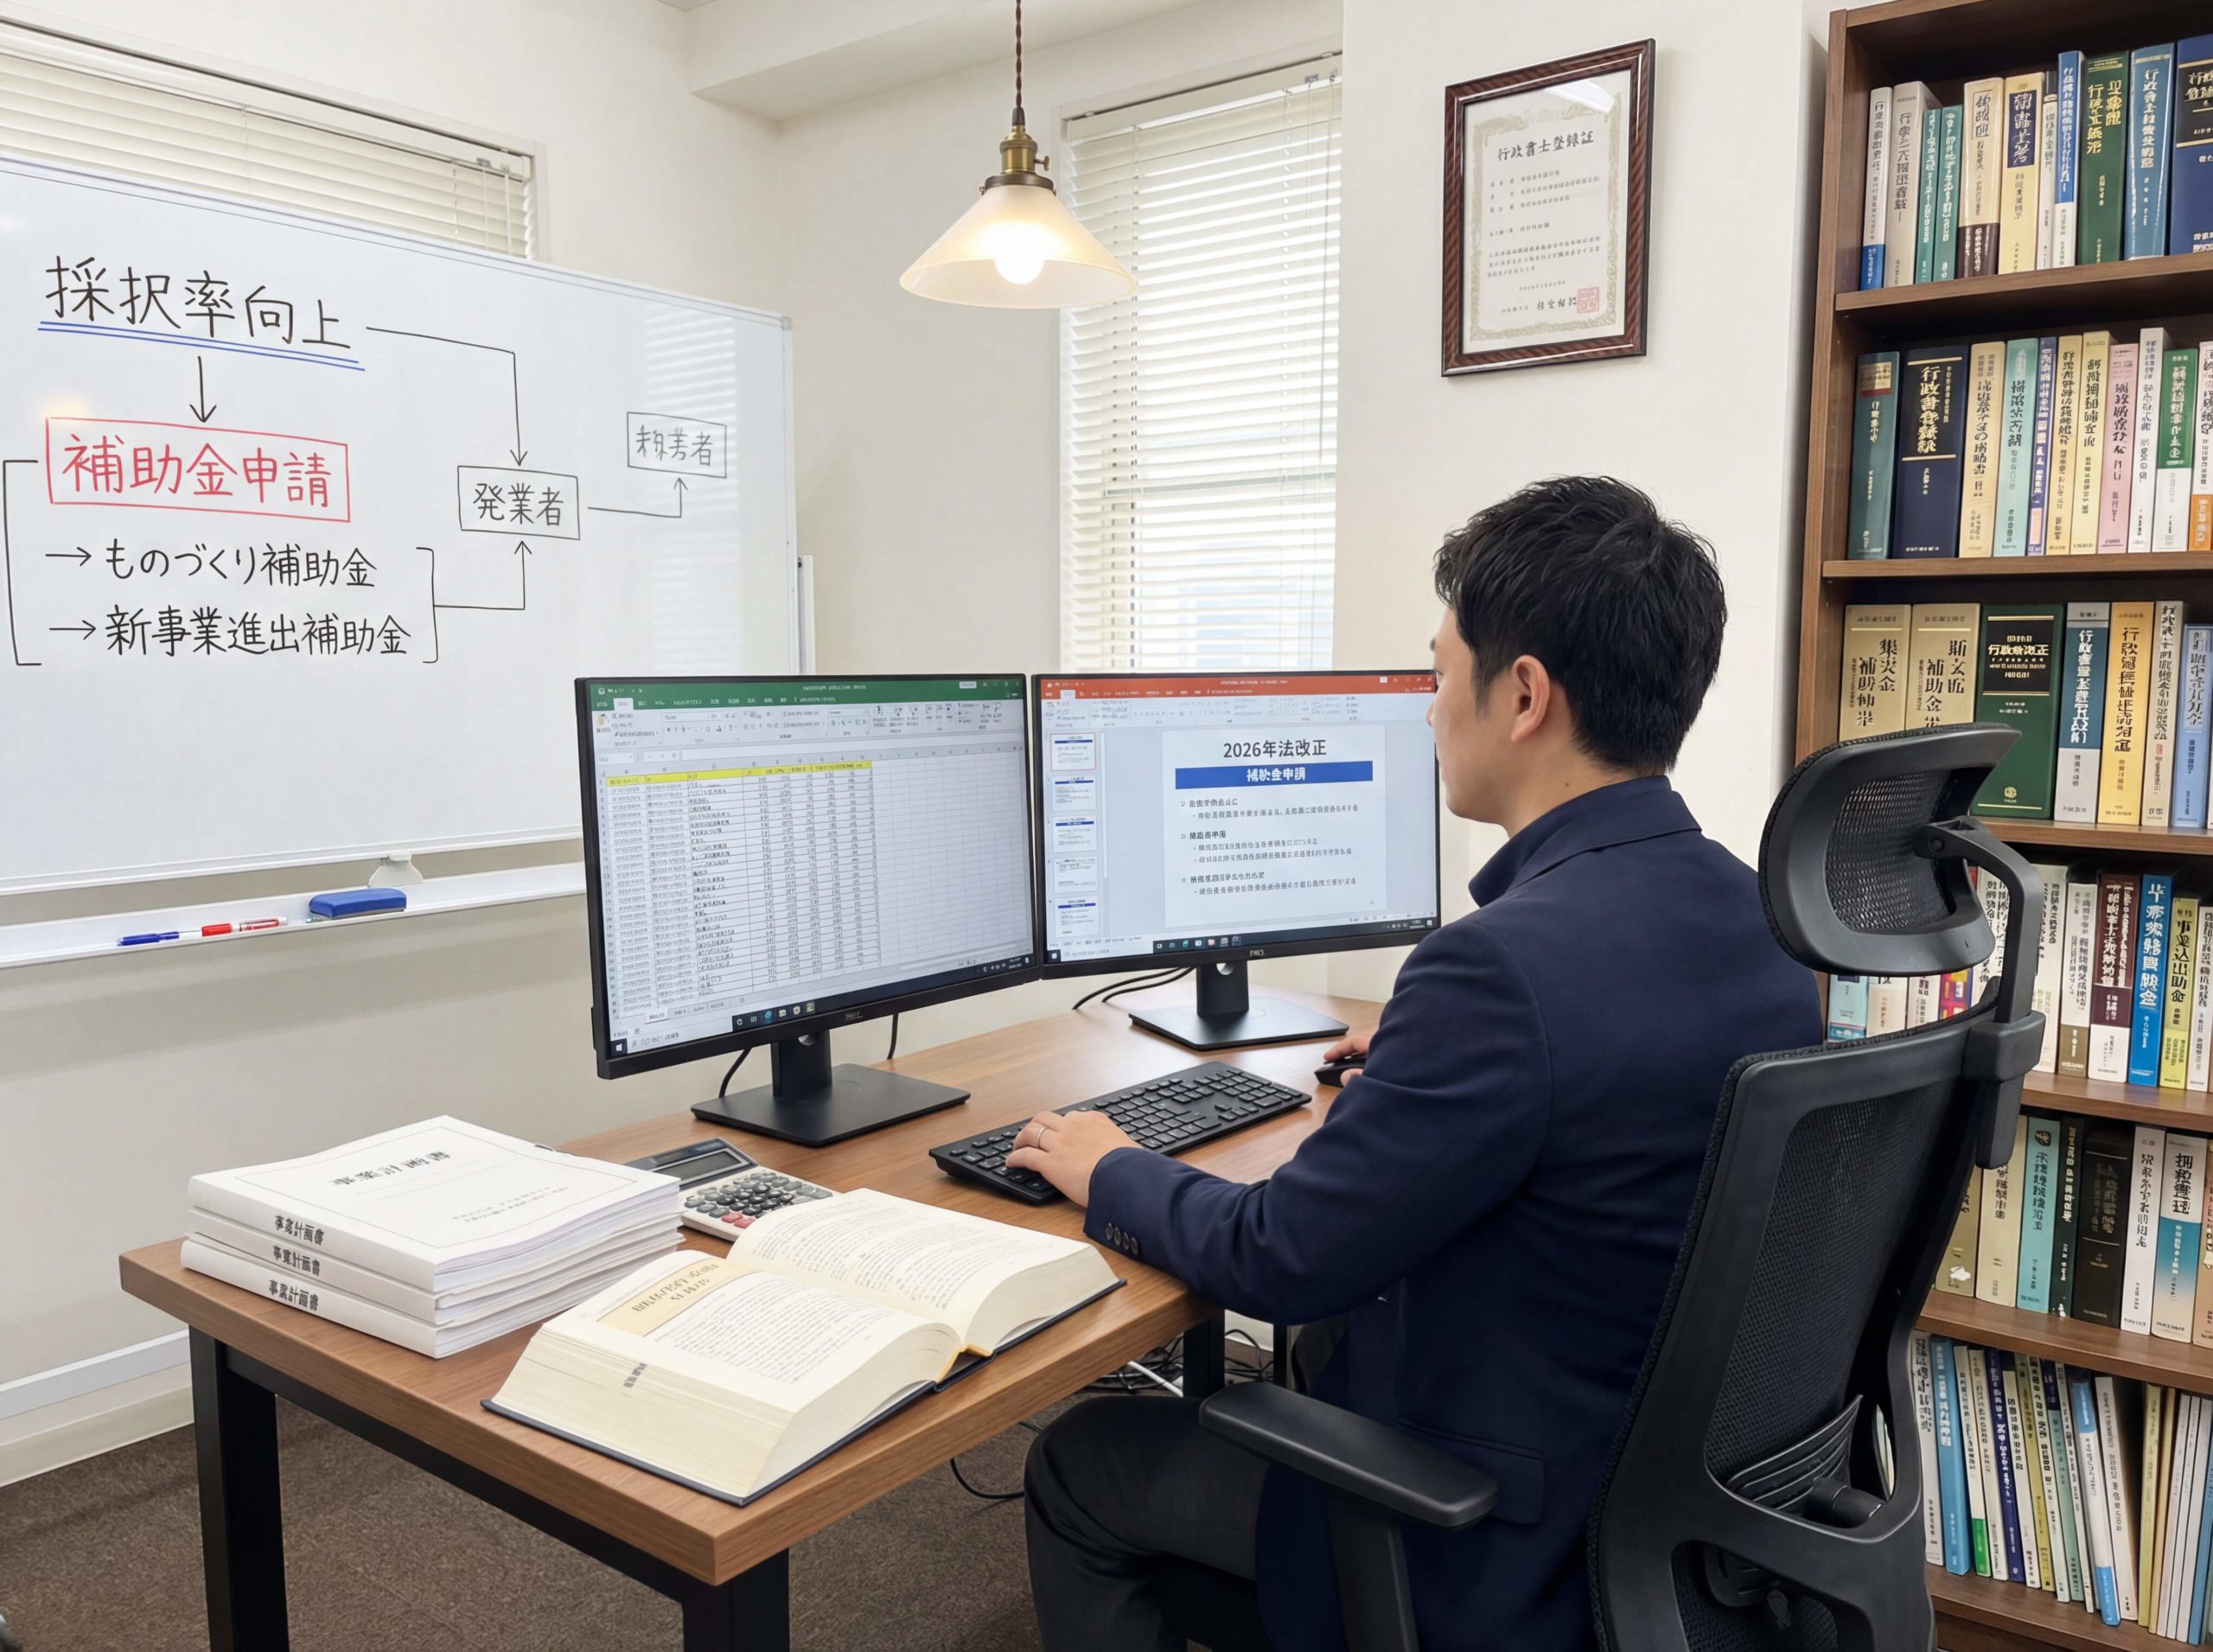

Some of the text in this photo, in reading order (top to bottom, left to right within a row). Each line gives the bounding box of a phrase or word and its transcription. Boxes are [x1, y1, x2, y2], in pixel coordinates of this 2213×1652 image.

[45, 255, 351, 348] 採択率向上
[61, 433, 333, 508] 補助金申請
[473, 482, 564, 526] 発業者
[105, 538, 379, 588] ものづくり補助金
[105, 603, 412, 657] 新事業進出補助金
[1222, 739, 1328, 759] 2026年法改正
